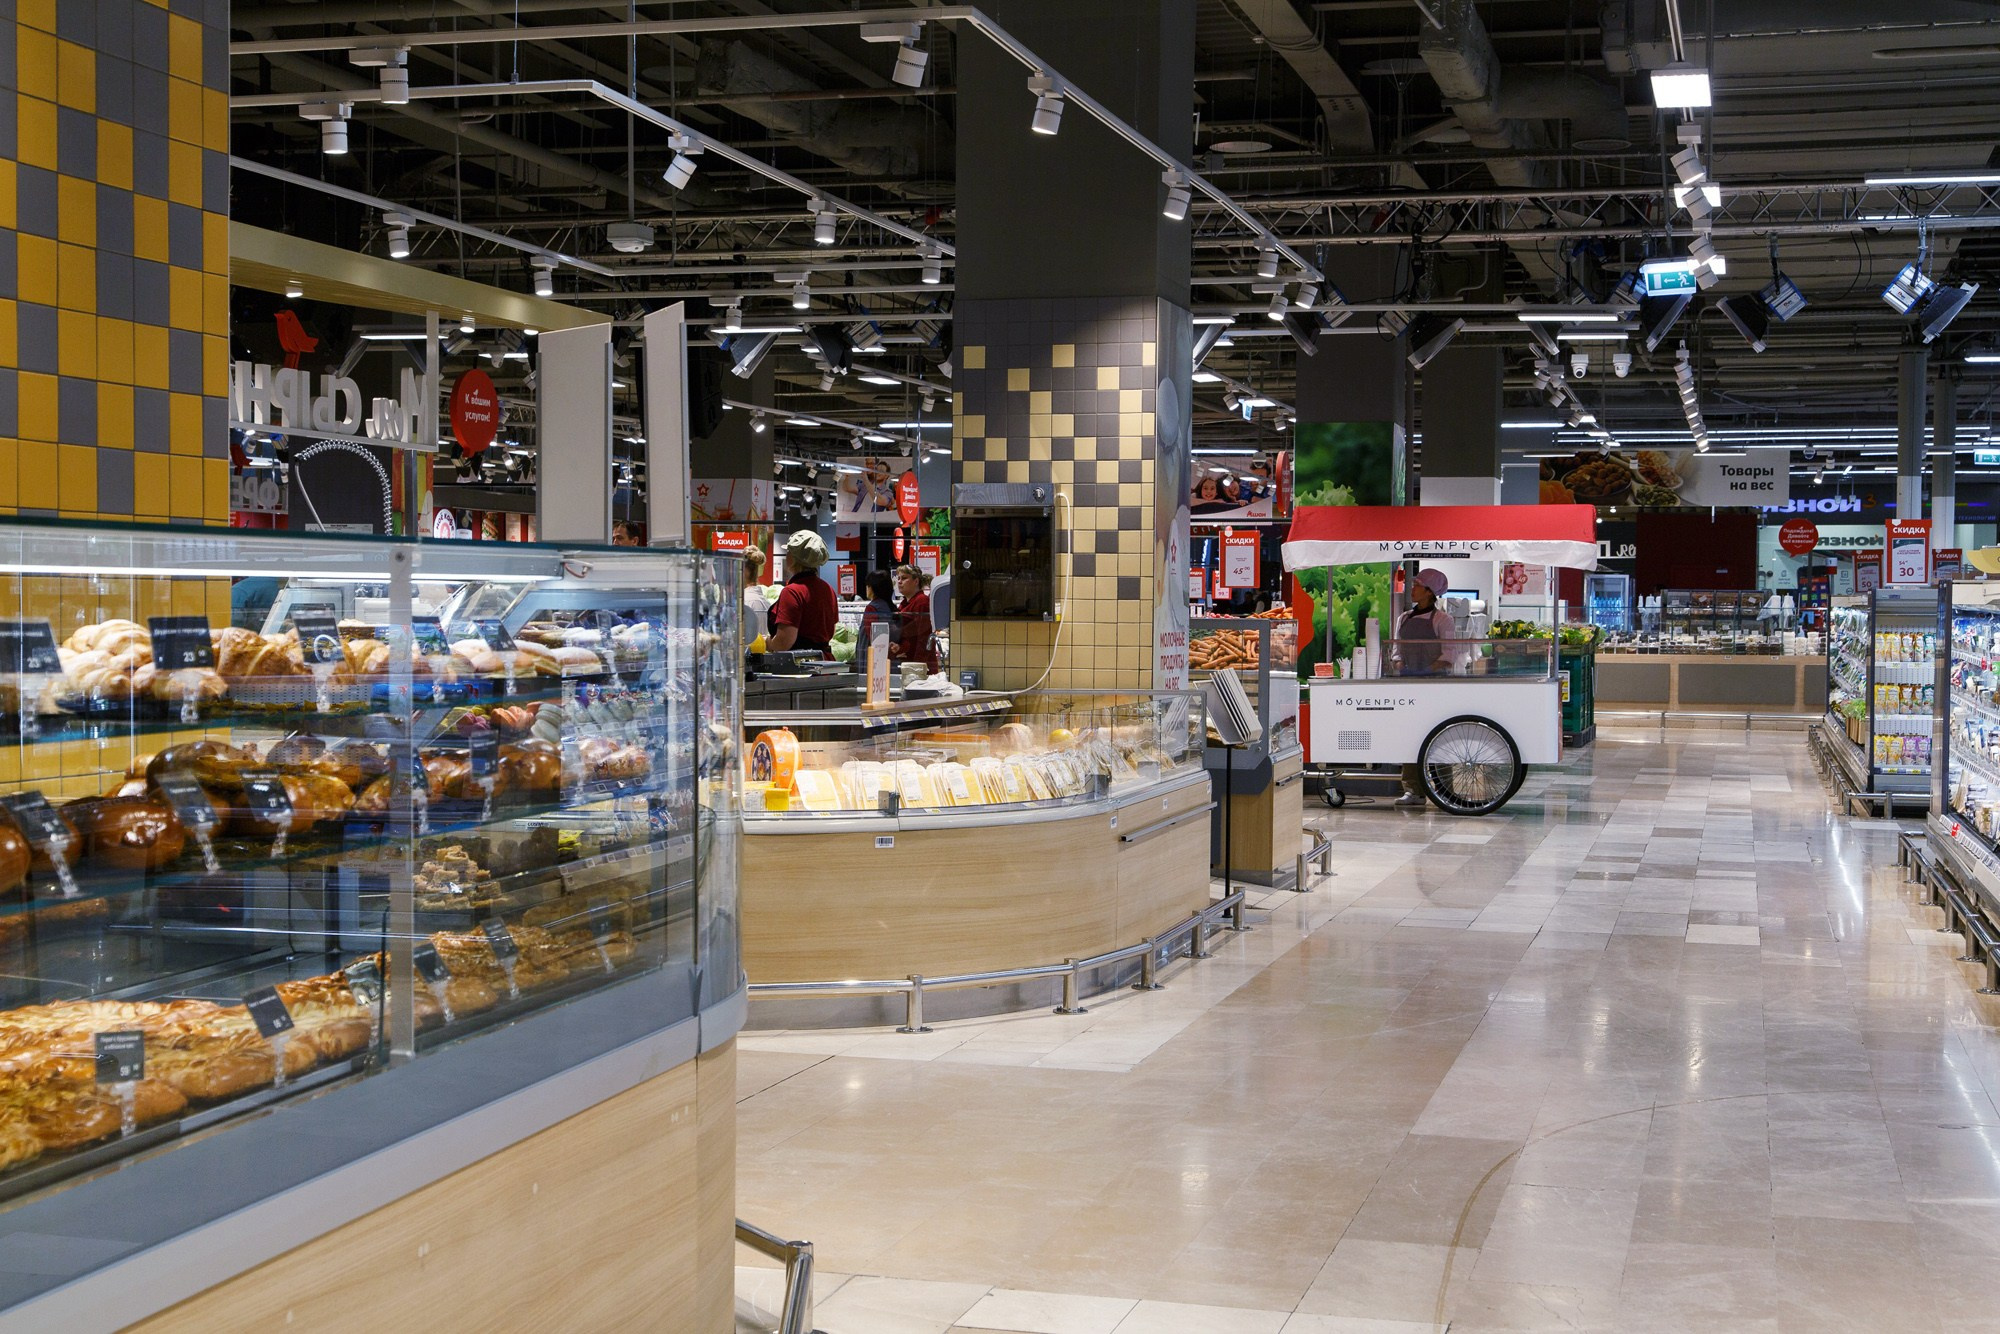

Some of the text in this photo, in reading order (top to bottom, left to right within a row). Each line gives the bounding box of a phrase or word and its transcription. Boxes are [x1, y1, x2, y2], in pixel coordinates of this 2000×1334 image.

[471, 397, 491, 407] вашим
[465, 411, 491, 423] услугам!
[1720, 465, 1774, 480] Товары
[1730, 481, 1774, 491] на вес
[1892, 527, 1926, 535] СКИДКА
[717, 539, 744, 547] СКИДКА
[1225, 537, 1255, 545] СКИДКИ
[1899, 567, 1915, 577] 30
